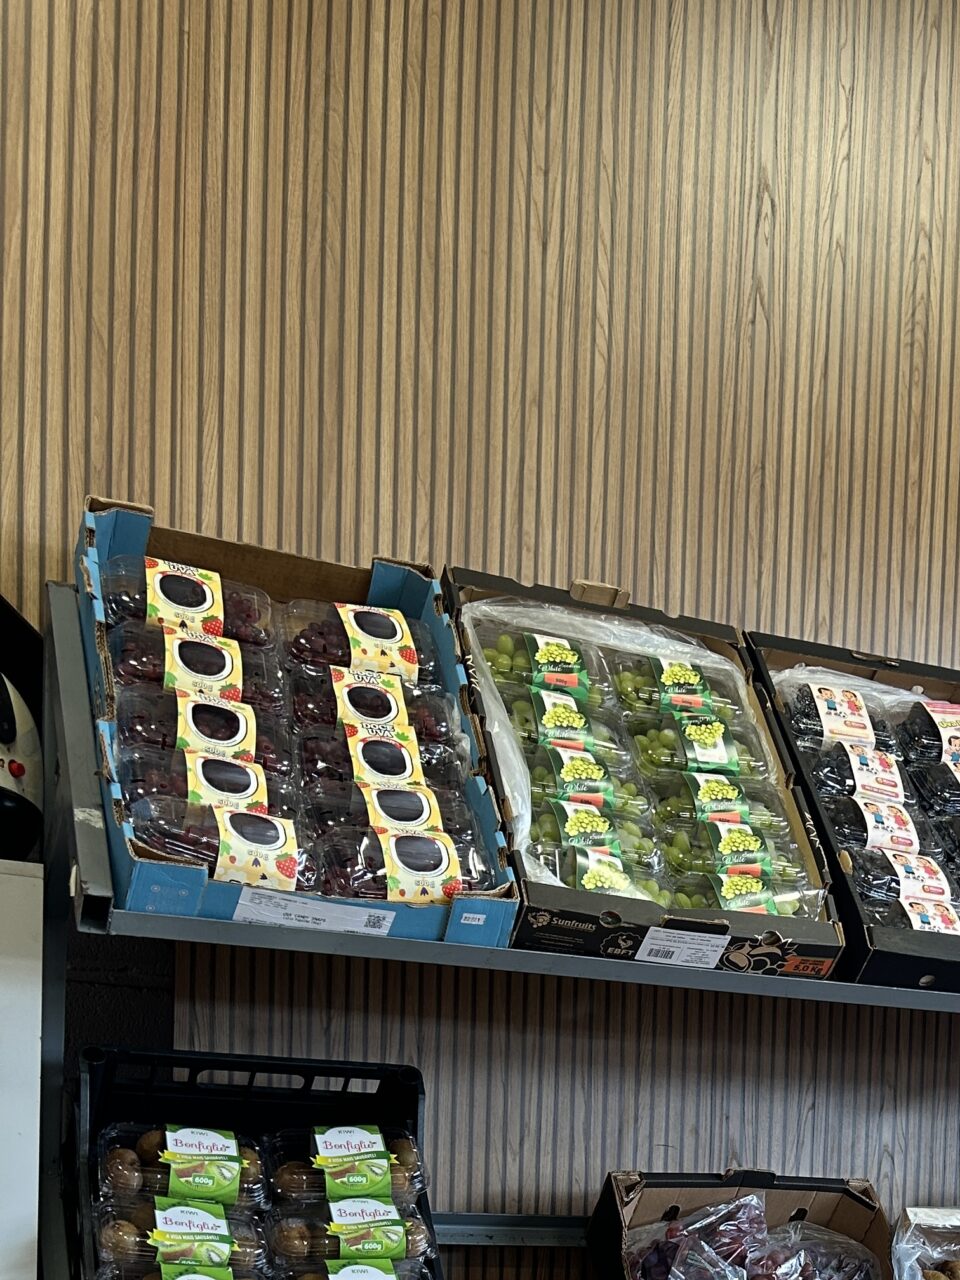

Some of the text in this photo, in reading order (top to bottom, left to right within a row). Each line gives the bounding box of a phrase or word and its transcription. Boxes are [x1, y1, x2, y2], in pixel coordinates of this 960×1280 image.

[361, 721, 395, 733] DOCE
[367, 728, 394, 739] UVA
[552, 916, 598, 931] Sunfruits
[172, 1138, 229, 1154] Bonfiglio
[322, 1140, 375, 1153] Bonfiglio
[193, 1176, 214, 1186] 600g
[348, 1175, 367, 1184] 600g
[336, 1208, 389, 1221] Bonfiglio
[162, 1216, 219, 1232] Bonfiglio
[363, 1243, 382, 1252] 600g
